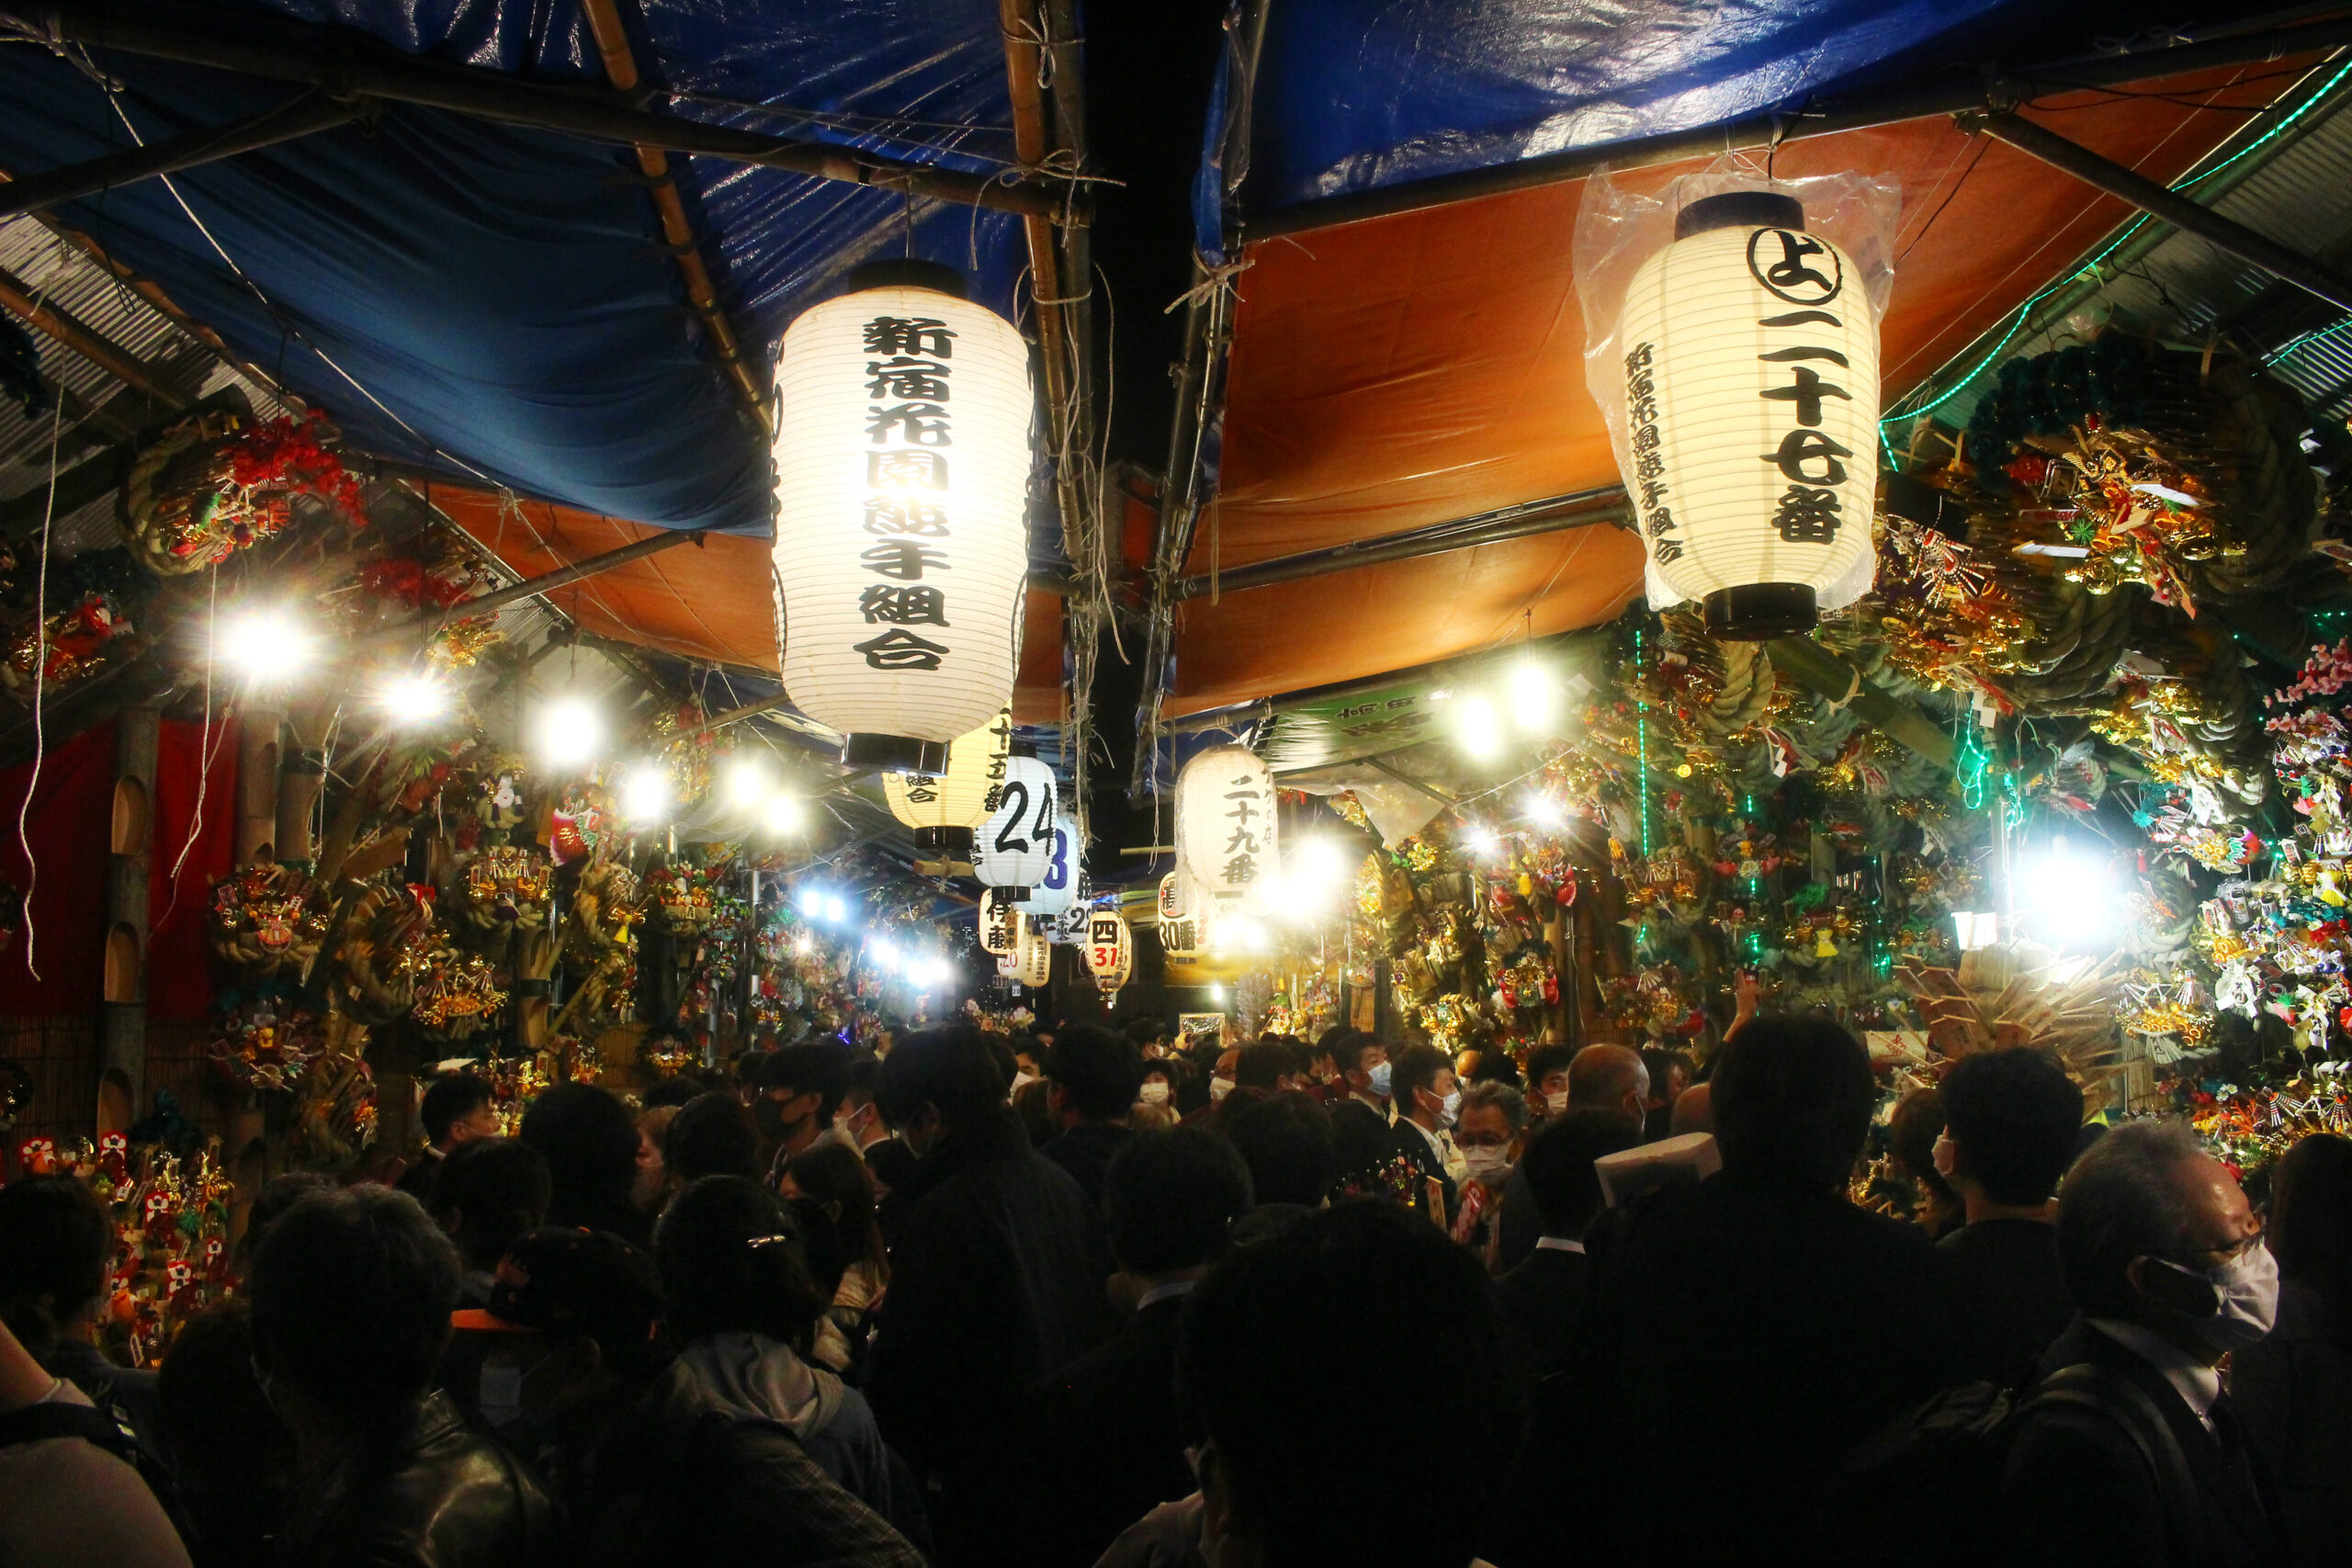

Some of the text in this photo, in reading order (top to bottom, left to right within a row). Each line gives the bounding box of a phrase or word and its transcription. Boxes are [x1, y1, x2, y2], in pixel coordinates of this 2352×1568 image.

[995, 781, 1056, 857] 24
[1219, 774, 1261, 885] 二十九番
[1092, 920, 1118, 944] 四
[1094, 947, 1117, 967] 31
